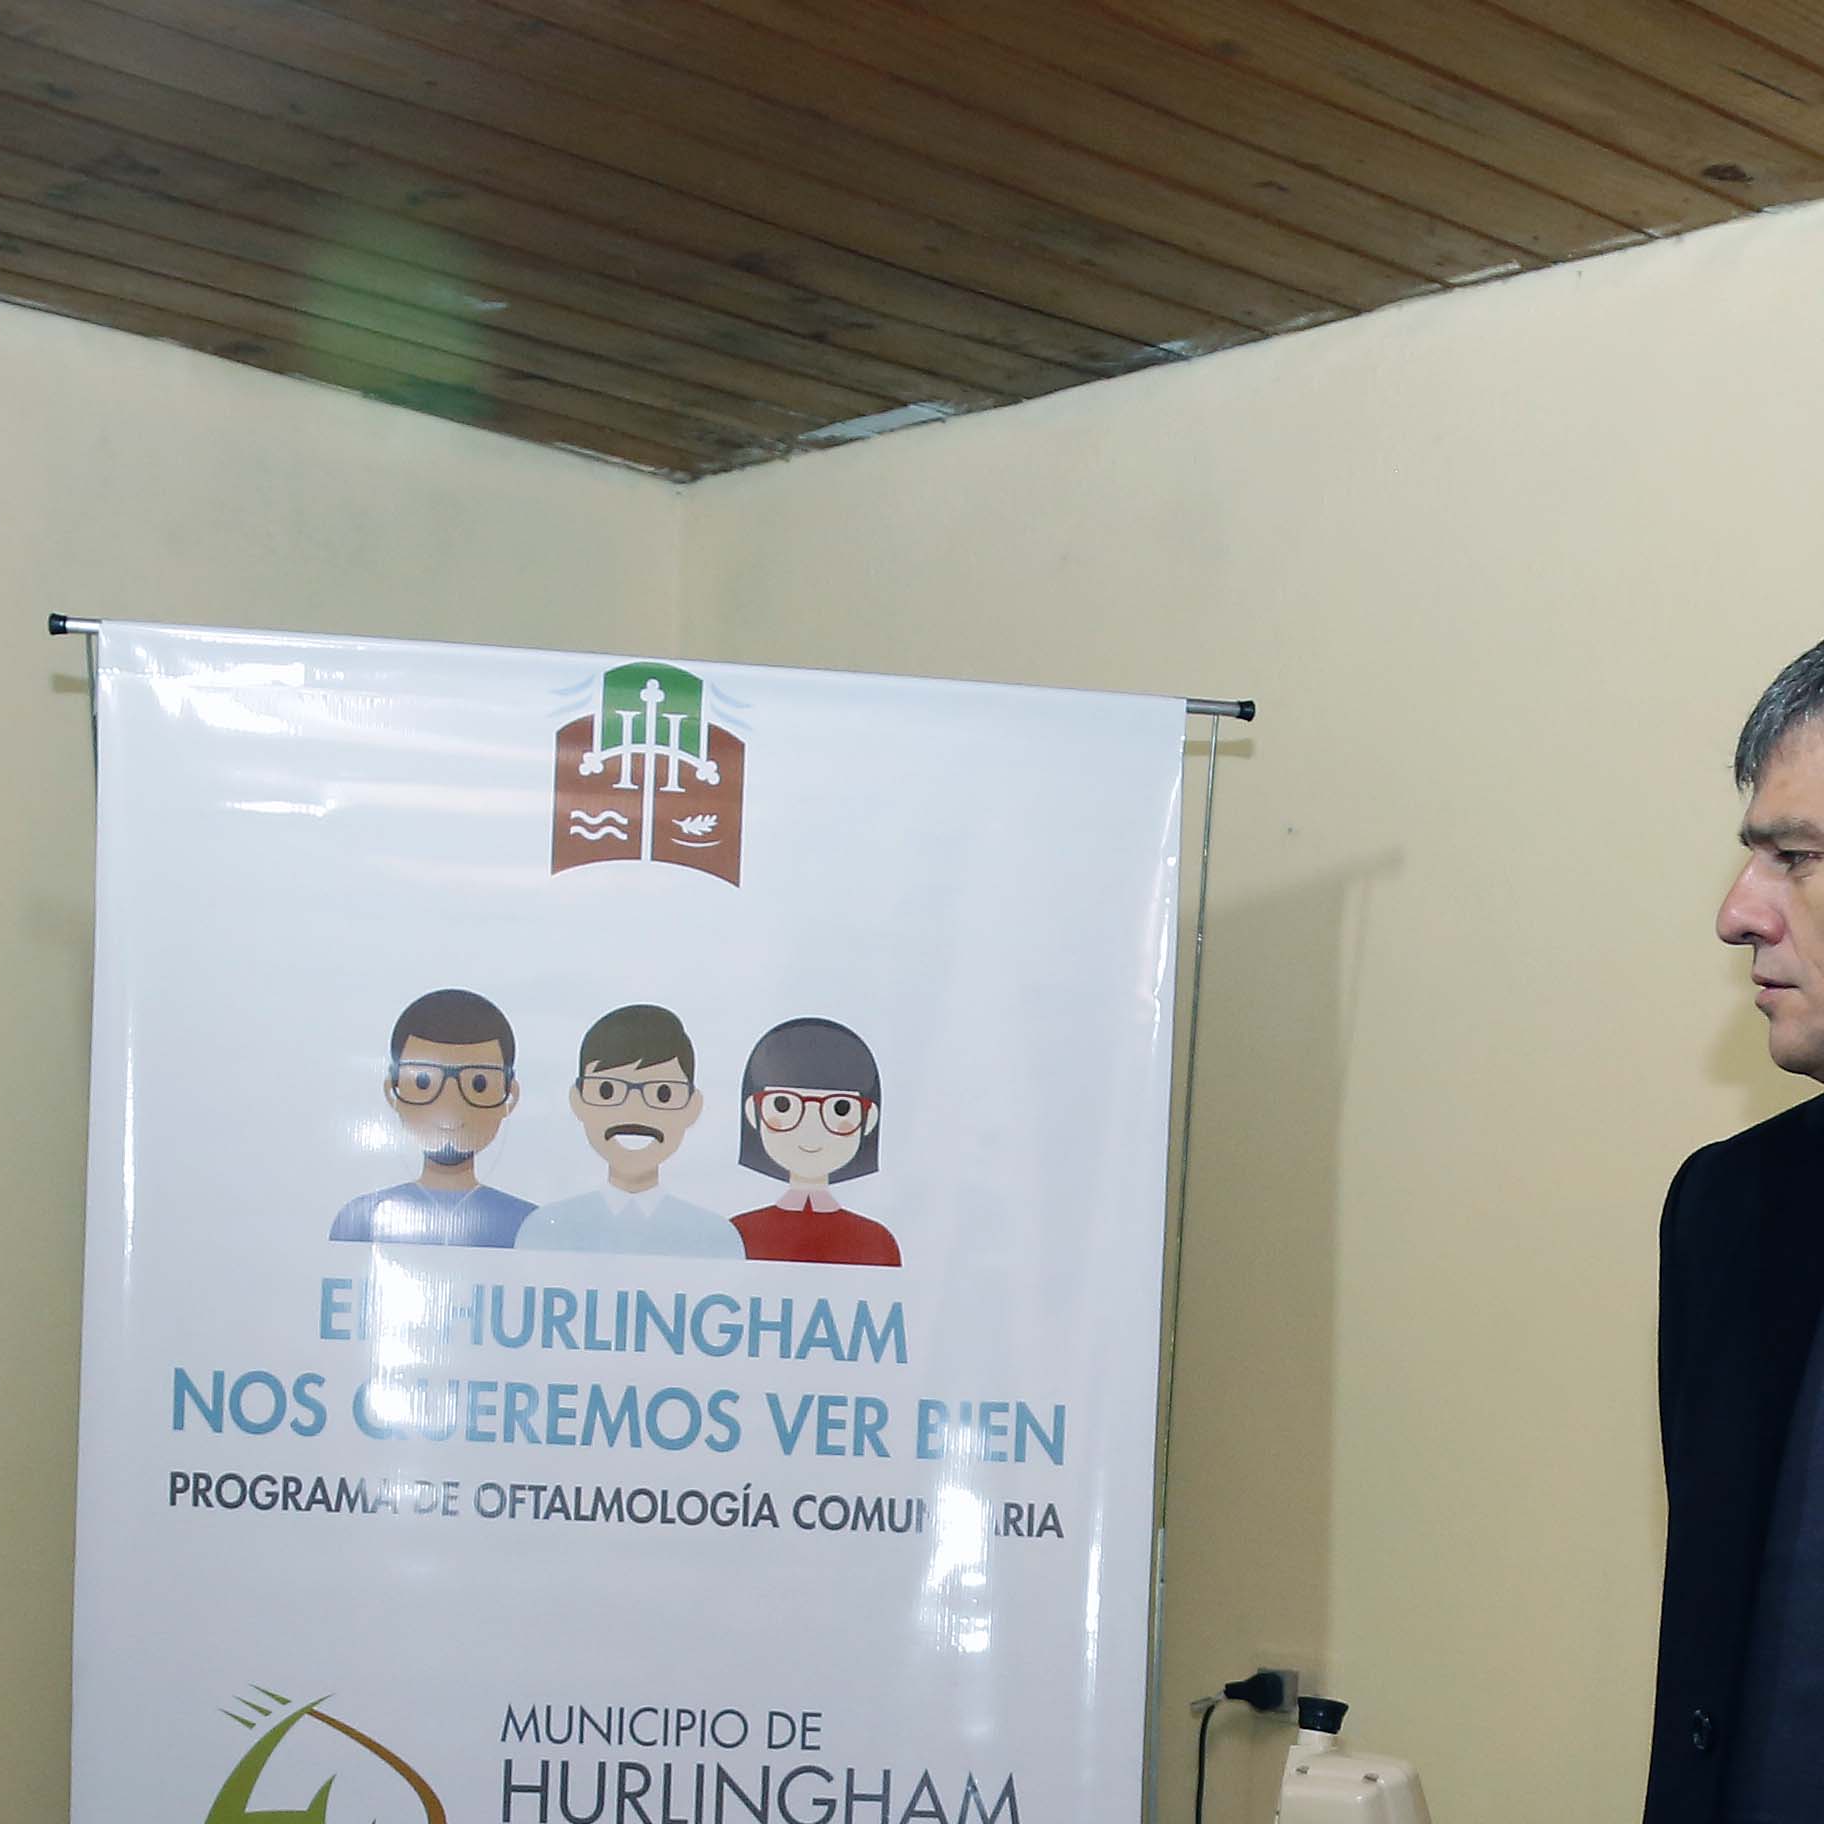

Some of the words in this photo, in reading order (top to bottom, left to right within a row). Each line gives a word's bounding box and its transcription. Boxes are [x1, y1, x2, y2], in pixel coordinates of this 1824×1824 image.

[172, 1367, 328, 1437] NOS
[766, 1392, 891, 1458] VER
[916, 1398, 1066, 1466] BIEN
[169, 1470, 399, 1516] PROGRAMA
[414, 1479, 460, 1517] DE
[473, 1482, 780, 1529] OFTALMOLOGÍA
[793, 1493, 1065, 1539] COMURIA
[500, 1704, 749, 1750] MUNICIPIO
[767, 1709, 823, 1752] DE
